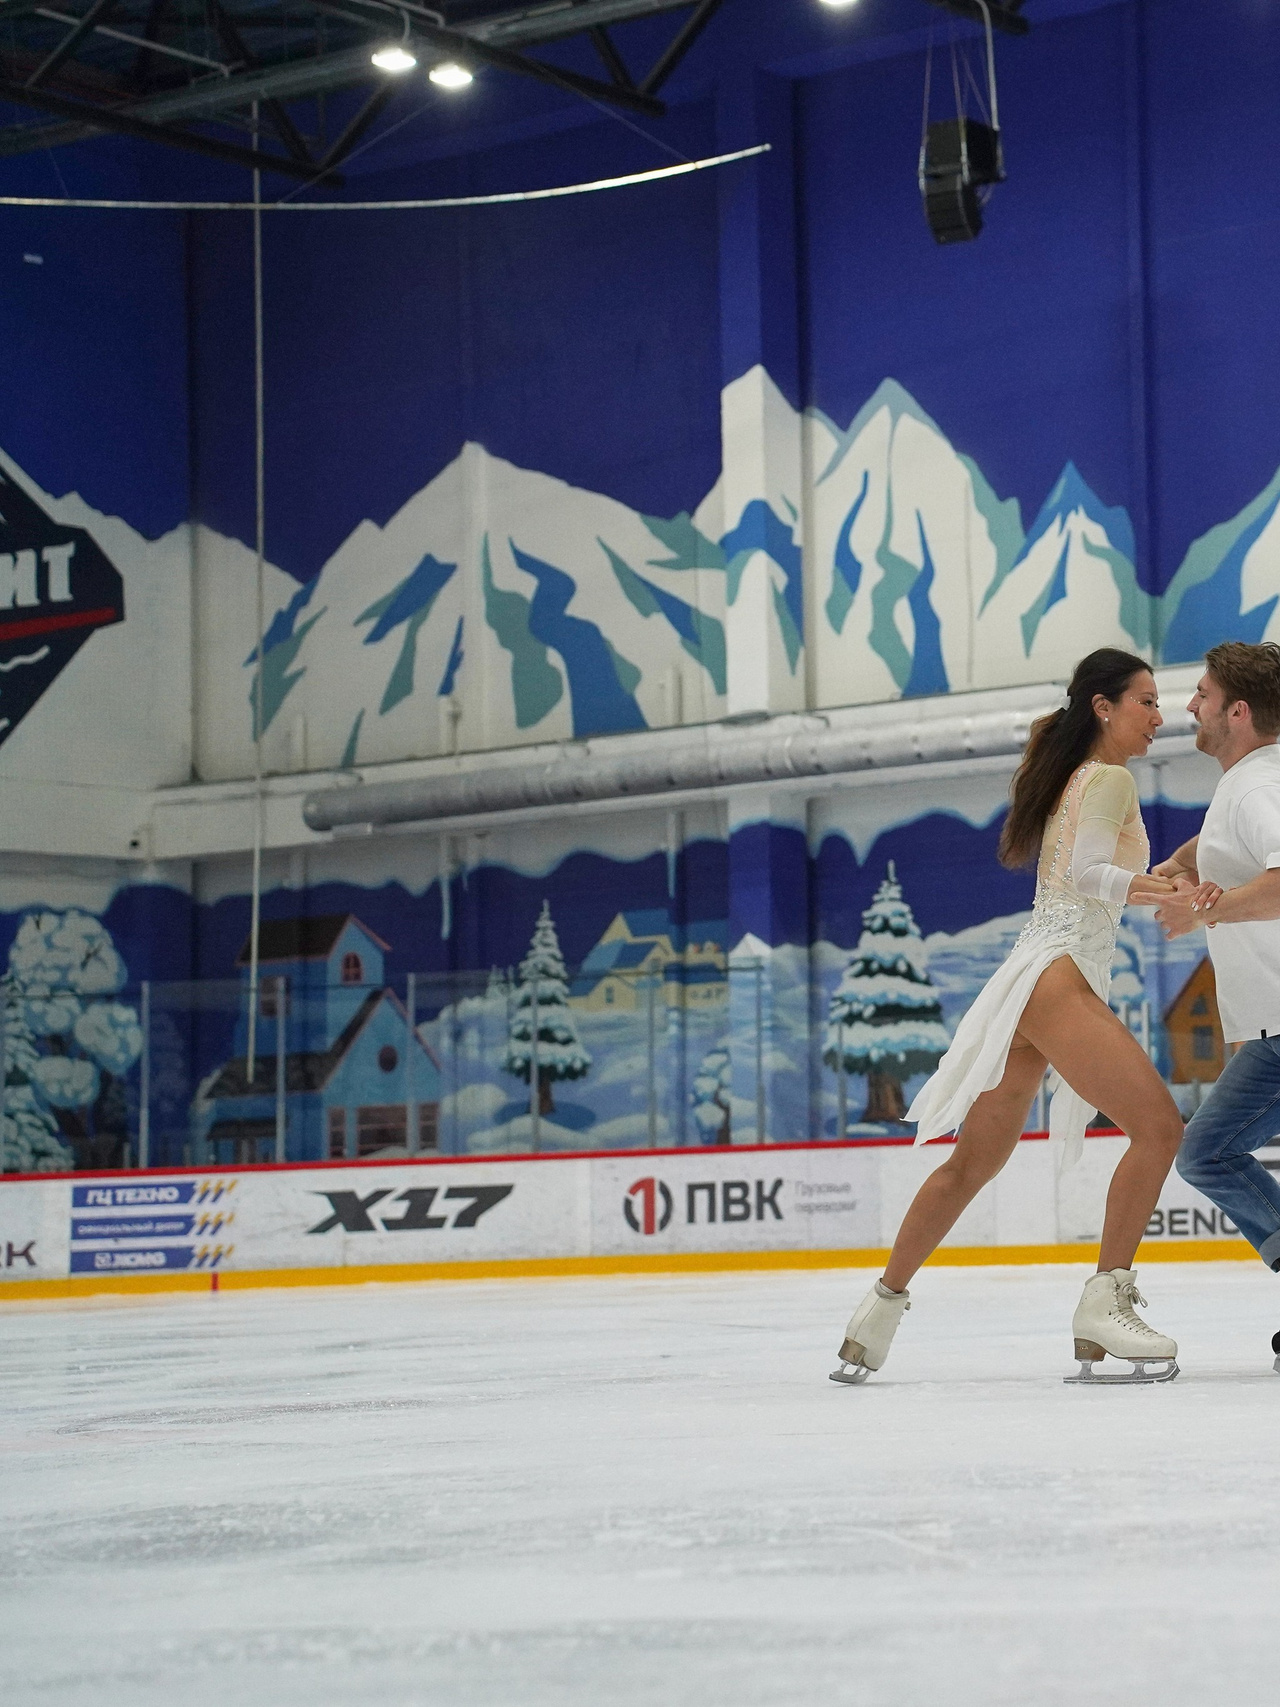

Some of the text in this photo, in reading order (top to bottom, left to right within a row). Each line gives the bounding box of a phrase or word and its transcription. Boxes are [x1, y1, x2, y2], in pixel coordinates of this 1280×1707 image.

[115, 1186, 180, 1204] ТЕХНО
[305, 1184, 514, 1234] X17
[686, 1178, 783, 1223] ПВК
[0, 1239, 37, 1267] K
